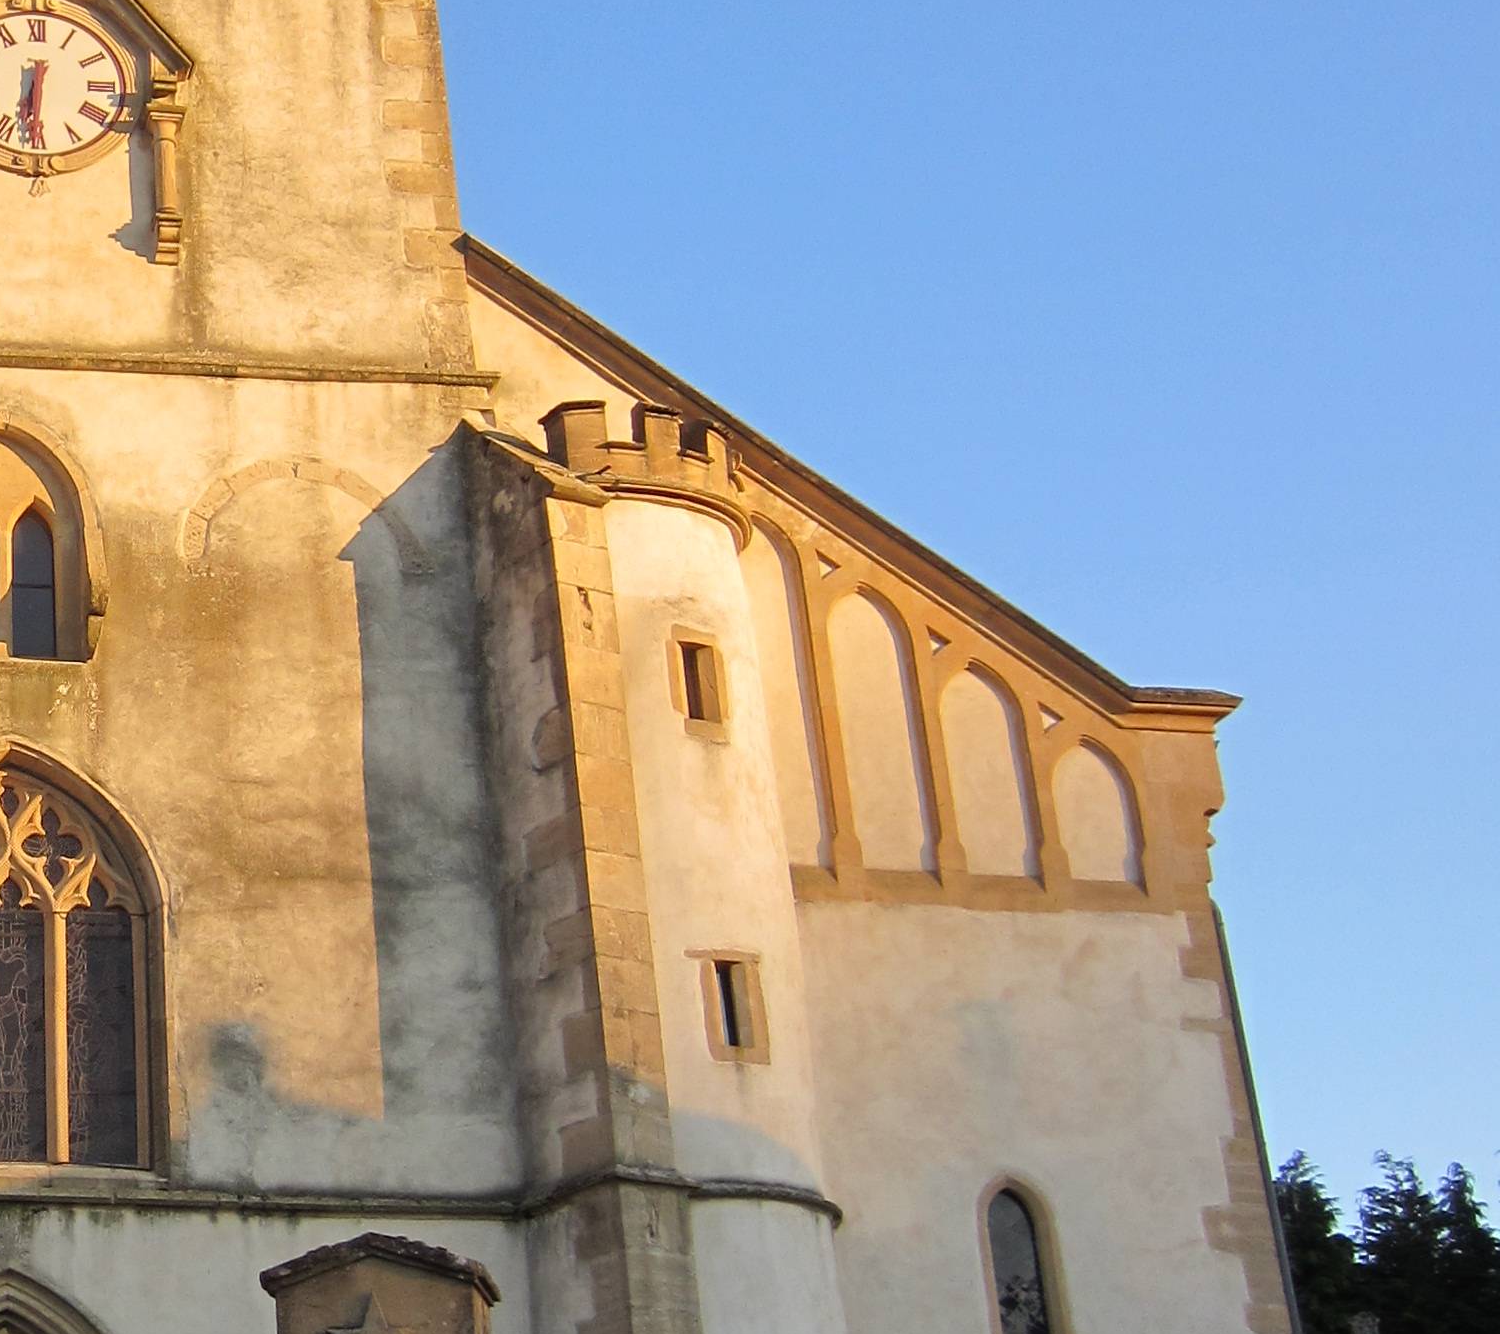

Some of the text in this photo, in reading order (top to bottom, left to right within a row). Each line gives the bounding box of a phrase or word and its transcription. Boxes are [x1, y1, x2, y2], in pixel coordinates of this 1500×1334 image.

[27, 19, 46, 42] XII
[60, 29, 76, 50] I
[79, 52, 105, 68] II
[87, 80, 115, 92] III
[64, 122, 82, 144] V
